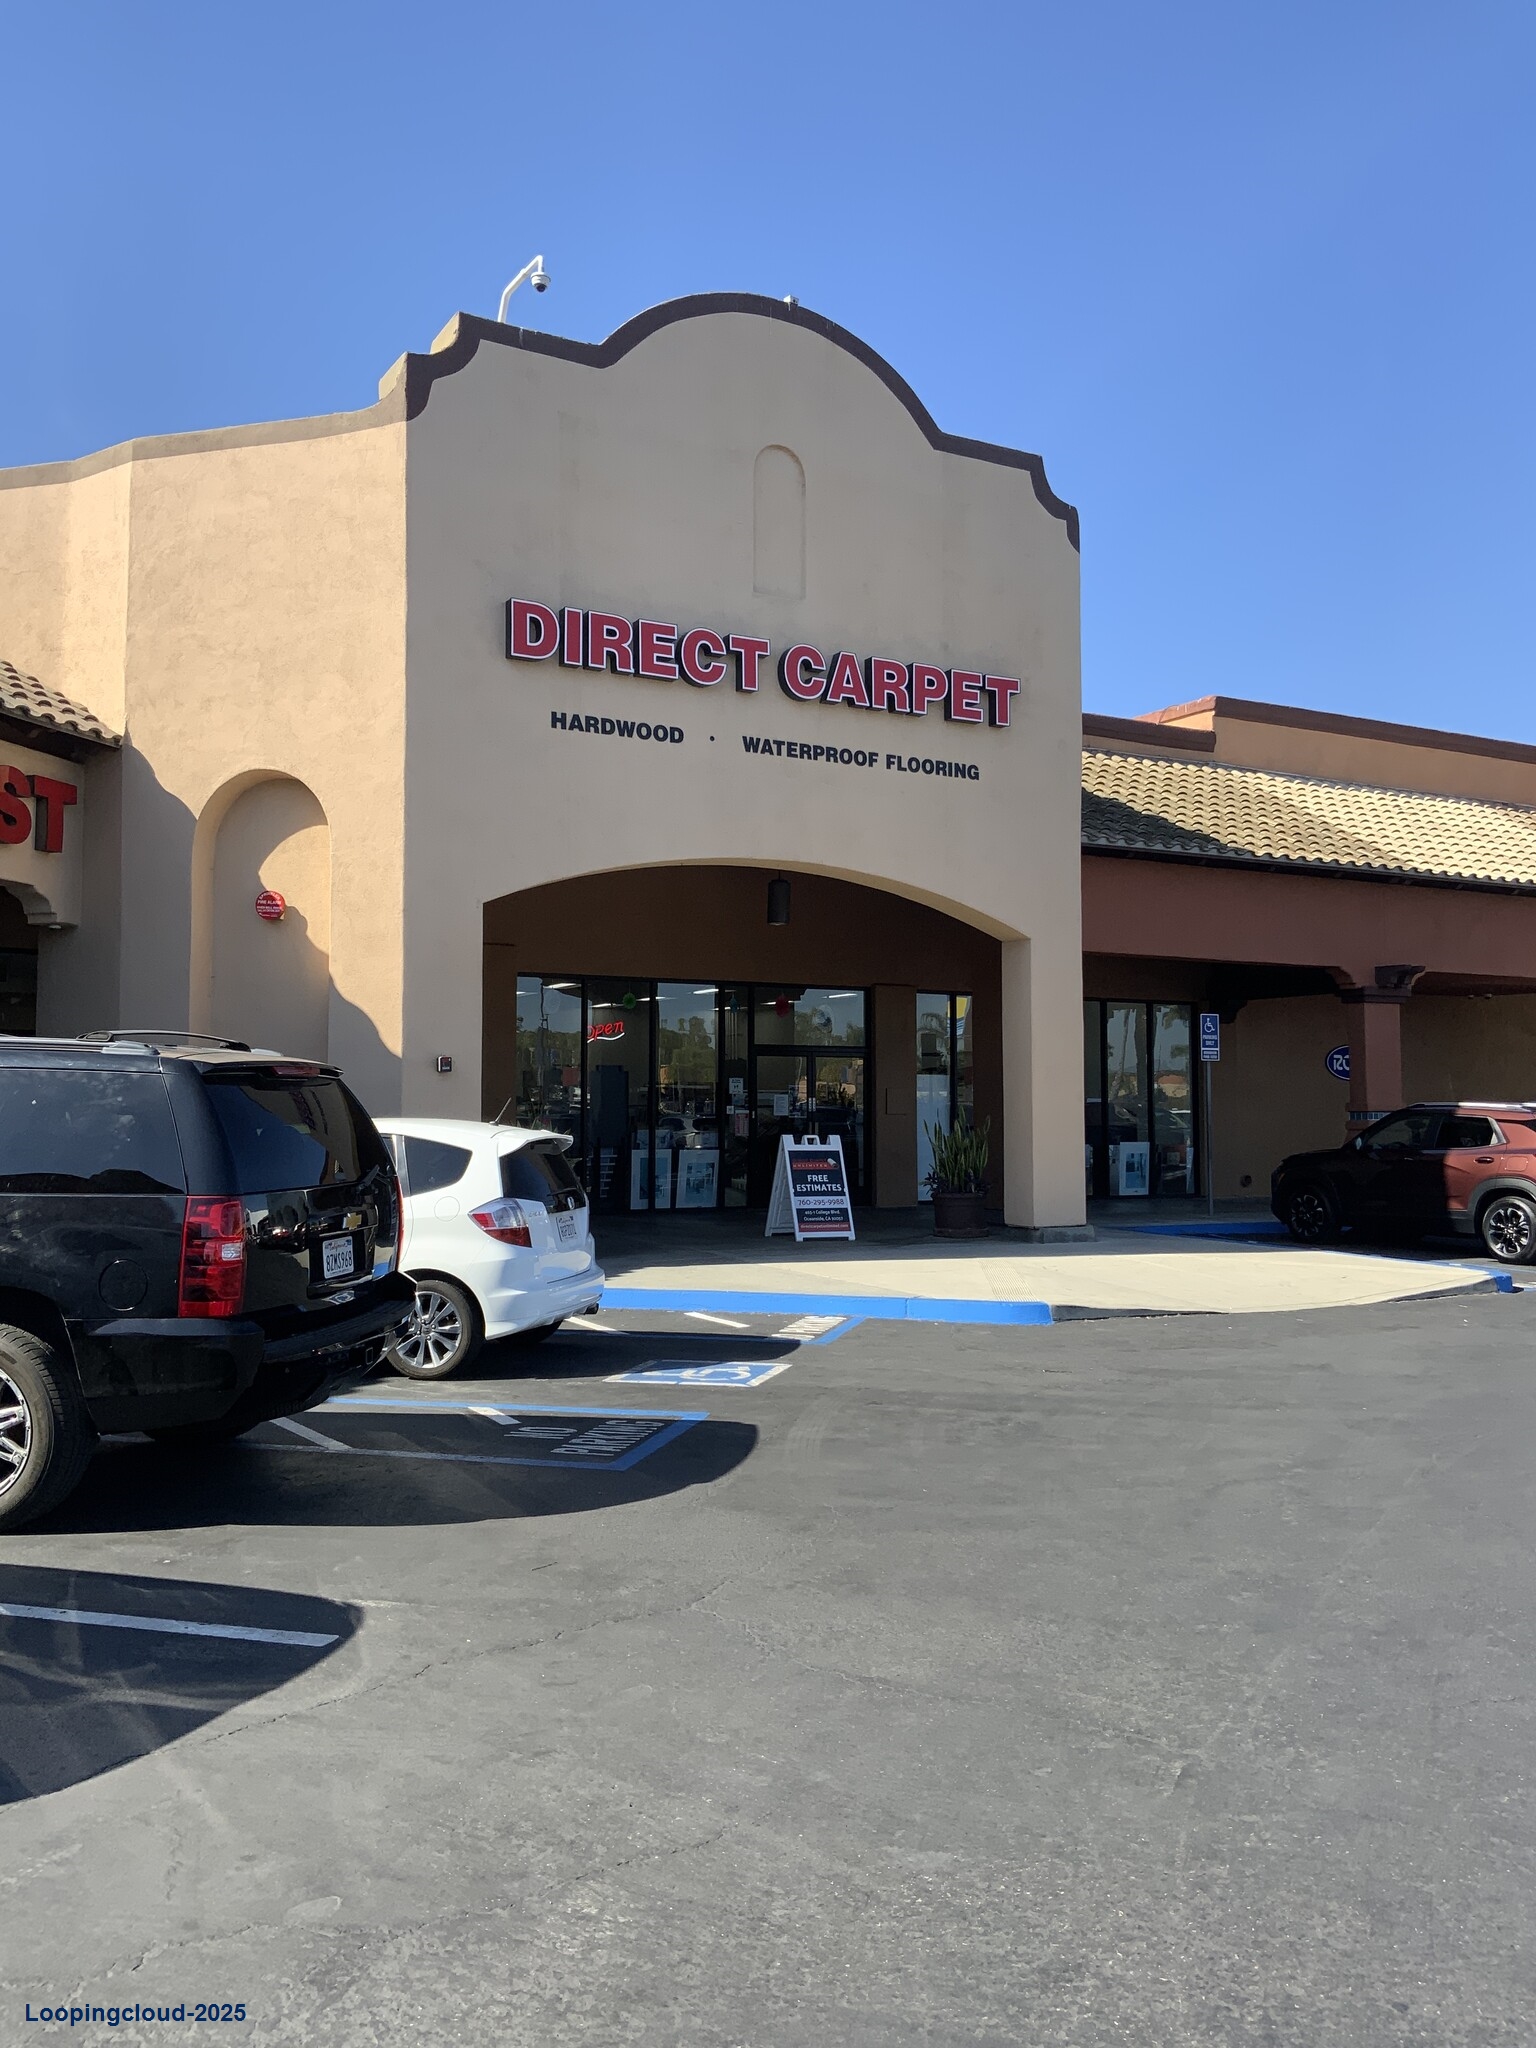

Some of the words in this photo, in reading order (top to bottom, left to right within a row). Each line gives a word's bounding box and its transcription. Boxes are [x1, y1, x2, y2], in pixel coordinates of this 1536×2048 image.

[506, 598, 770, 692] DIRECT
[778, 643, 1021, 728] CARPET
[551, 711, 684, 744] HARDWOOD
[742, 736, 879, 768] WATERPROOF
[886, 754, 980, 781] FLOORING
[796, 1184, 842, 1192] ESTIMATES
[807, 1174, 829, 1182] FREE
[504, 1426, 577, 1440] NO
[550, 1420, 665, 1456] PARKING
